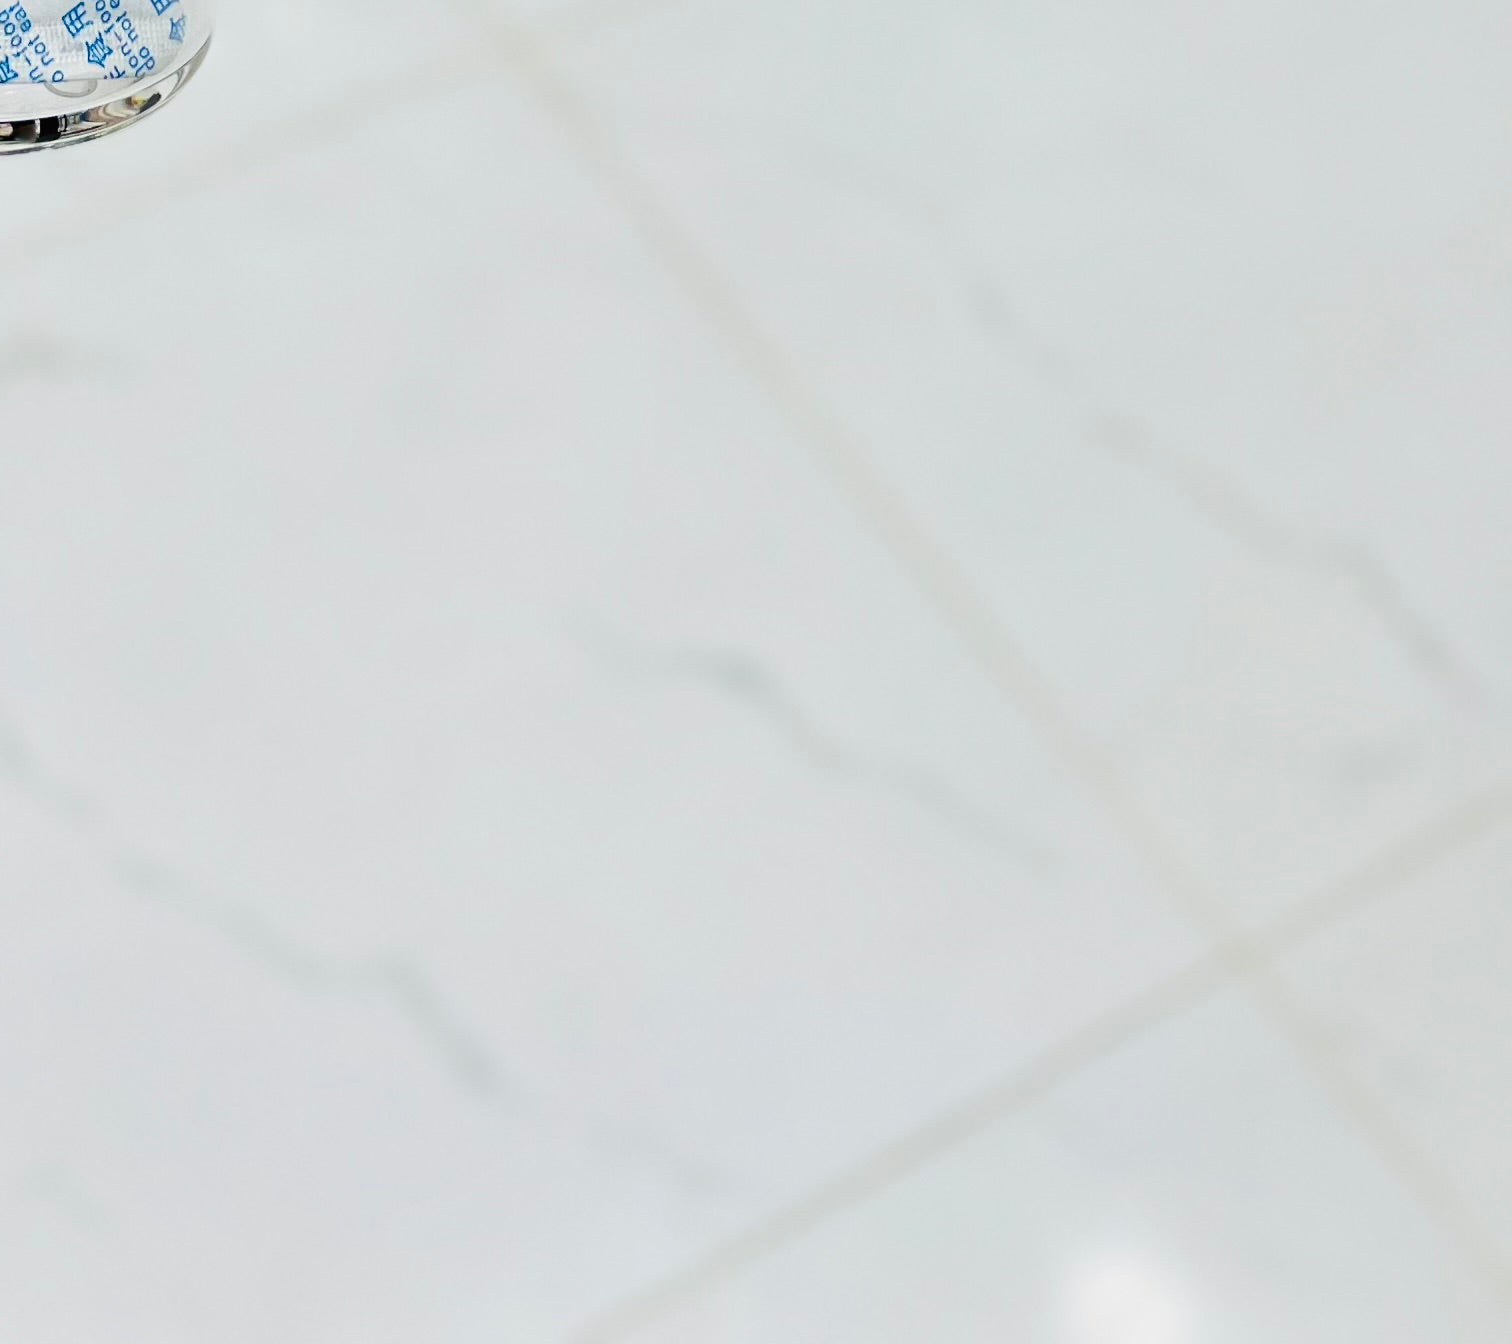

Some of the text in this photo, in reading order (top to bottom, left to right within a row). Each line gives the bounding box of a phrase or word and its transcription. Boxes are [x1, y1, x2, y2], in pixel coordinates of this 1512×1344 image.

[8, 1, 32, 33] eat
[115, 10, 138, 43] not
[27, 34, 54, 66] not
